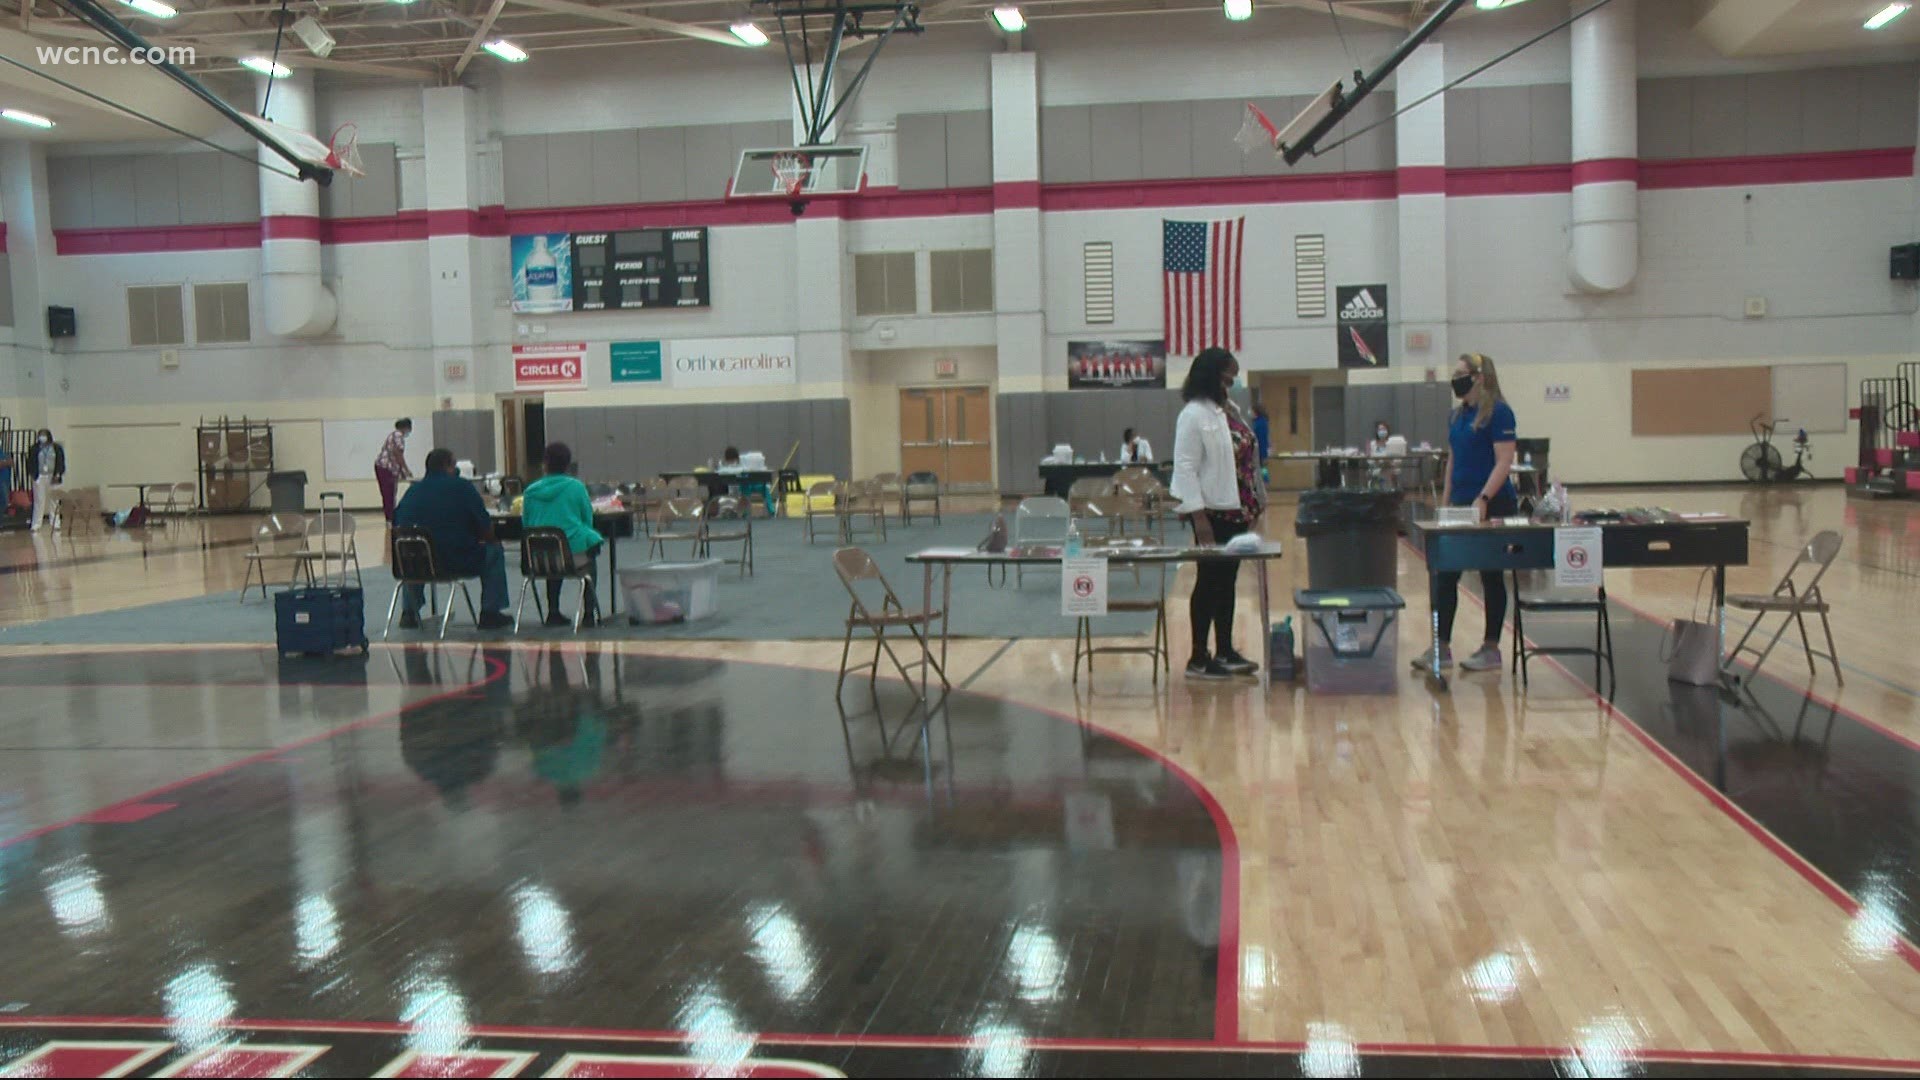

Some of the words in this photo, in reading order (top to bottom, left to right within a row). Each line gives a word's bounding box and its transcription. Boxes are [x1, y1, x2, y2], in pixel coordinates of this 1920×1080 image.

[576, 234, 607, 244] GUEST
[672, 231, 700, 240] HOME
[614, 261, 643, 270] PERIOD
[1340, 308, 1384, 319] adidas
[520, 364, 559, 376] CIRCLE
[562, 361, 576, 377] K
